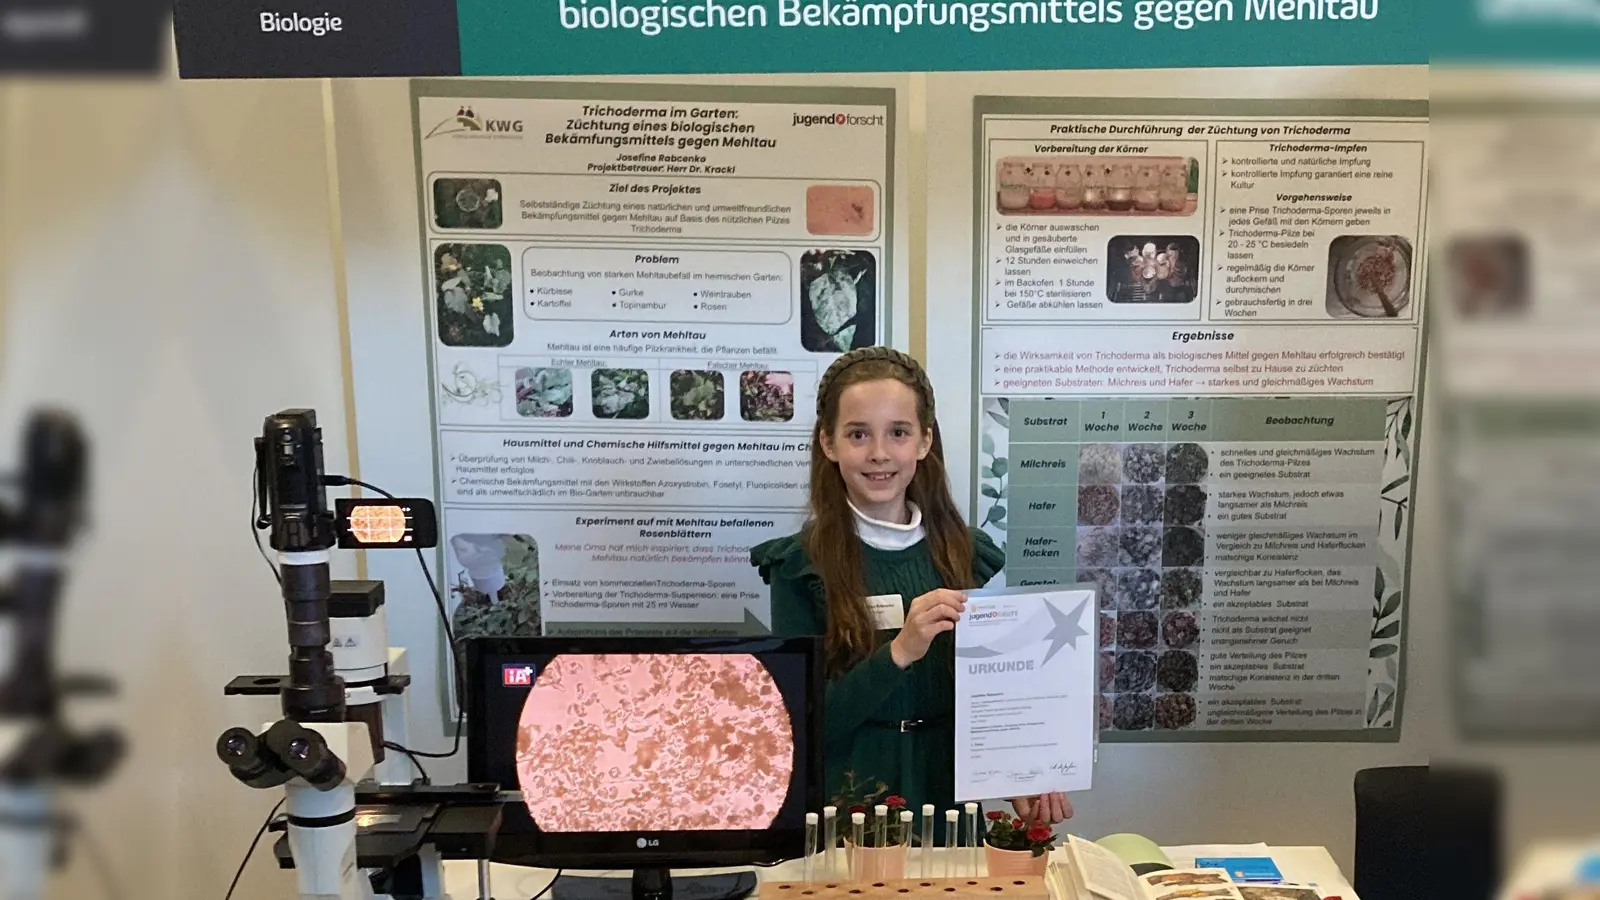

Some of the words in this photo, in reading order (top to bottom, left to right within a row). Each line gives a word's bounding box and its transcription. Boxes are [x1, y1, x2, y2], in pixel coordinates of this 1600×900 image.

[560, 0, 766, 35] biologischen
[779, 0, 1122, 32] Bekämpfungsmittels
[1134, 0, 1233, 30] gegen
[1245, 0, 1378, 20] Mehltau
[260, 12, 342, 36] Biologie
[582, 105, 667, 118] Trichoderma
[669, 106, 686, 118] im
[690, 106, 738, 119] Garten:
[792, 113, 834, 126] jugend
[846, 114, 884, 126] forscht
[485, 120, 523, 133] KWG
[567, 120, 629, 135] Züchtung
[632, 120, 668, 133] eines
[670, 121, 755, 136] biologischen
[1051, 125, 1106, 134] Praktische
[1108, 125, 1182, 136] Durchführung
[1187, 125, 1204, 134] der
[1207, 125, 1257, 136] Züchtung
[1283, 125, 1351, 135] Trichoderma
[677, 137, 719, 150] gegen
[722, 135, 776, 148] Mehltau
[1034, 144, 1096, 155] Vorbereitung
[1098, 145, 1113, 153] der
[1116, 145, 1148, 153] Körner
[1270, 144, 1367, 154] Trichoderma-Impfen
[616, 153, 656, 162] Josefine
[658, 154, 706, 163] Rabcenko
[1232, 157, 1278, 165] kontrollierte
[1280, 157, 1296, 166] und
[1297, 158, 1336, 166] natürliche
[1338, 158, 1371, 168] Impfung
[666, 164, 687, 173] Herr
[689, 164, 701, 173] Dr.
[1231, 170, 1278, 178] kontrollierte
[1279, 170, 1313, 180] Impfung
[1313, 170, 1352, 180] garantiert
[1353, 171, 1371, 179] eine
[1372, 171, 1393, 179] reine
[609, 183, 628, 194] Ziel
[630, 183, 650, 194] des
[651, 184, 701, 196] Projektes
[1231, 181, 1254, 189] Kultur
[1276, 193, 1352, 203] Vorgehensweise
[1006, 224, 1018, 232] die
[1020, 224, 1047, 232] Körner
[1049, 224, 1099, 232] auswaschen
[1006, 234, 1020, 242] und
[1031, 234, 1077, 244] gesäuberte
[1005, 246, 1051, 255] Glasgefäße
[1053, 246, 1087, 254] einfüllen
[635, 254, 679, 265] Problem
[1005, 257, 1015, 265] 12
[1017, 257, 1051, 265] Stunden
[1053, 257, 1098, 265] einweichen
[1005, 268, 1031, 276] lassen
[1016, 279, 1053, 287] Backofen
[1059, 279, 1062, 287] 1
[1066, 279, 1094, 287] Stunde
[537, 287, 572, 296] Kürbisse
[619, 288, 644, 297] Gurke
[700, 290, 751, 299] Weintrauben
[537, 300, 571, 308] Kartoffel
[620, 301, 666, 312] Topinambur
[701, 302, 727, 311] Rosen
[1007, 300, 1036, 309] Gefäße
[1038, 301, 1075, 309] abkühlen
[1076, 301, 1103, 309] lassen
[610, 330, 638, 340] Arten
[641, 332, 660, 340] von
[662, 331, 706, 341] Mehltau
[1172, 331, 1234, 343] Ergebnisse
[1004, 351, 1017, 360] die
[1019, 351, 1073, 360] Wirksamkeit
[1093, 351, 1150, 360] Trichoderma
[1152, 351, 1165, 360] als
[1168, 351, 1222, 362] biologisches
[1224, 351, 1249, 360] Mittel
[1250, 353, 1279, 362] gegen
[1281, 350, 1316, 360] Mehltau
[1318, 350, 1365, 361] erfolgreich
[1367, 350, 1405, 361] bestätigt
[1004, 364, 1023, 373] eine
[1024, 364, 1072, 375] praktikable
[1074, 364, 1114, 373] Methode
[1164, 364, 1220, 373] Trichoderma
[1222, 364, 1249, 373] selbst
[1263, 364, 1293, 373] Hause
[1307, 363, 1343, 373] züchten
[1024, 416, 1067, 426] Substrat
[1266, 416, 1334, 426] Beobachtung
[503, 438, 560, 448] Hausmittel
[563, 439, 584, 448] und
[586, 439, 644, 449] Chemische
[647, 440, 700, 450] Hilfsmittel
[702, 443, 735, 452] gegen
[737, 441, 779, 451] Mehltau
[781, 442, 795, 451] im
[1020, 459, 1066, 468] Milchreis
[1029, 501, 1056, 510] Hafer
[576, 517, 634, 528] Experiment
[636, 517, 653, 526] auf
[655, 518, 673, 526] mit
[675, 518, 717, 527] Mehltau
[719, 518, 774, 527] befallenen
[640, 530, 711, 538] Rosenblättern
[1025, 537, 1057, 545] Hafer-
[1023, 548, 1059, 557] flocken
[969, 612, 992, 620] jugend
[968, 660, 1034, 674] URKUNDE
